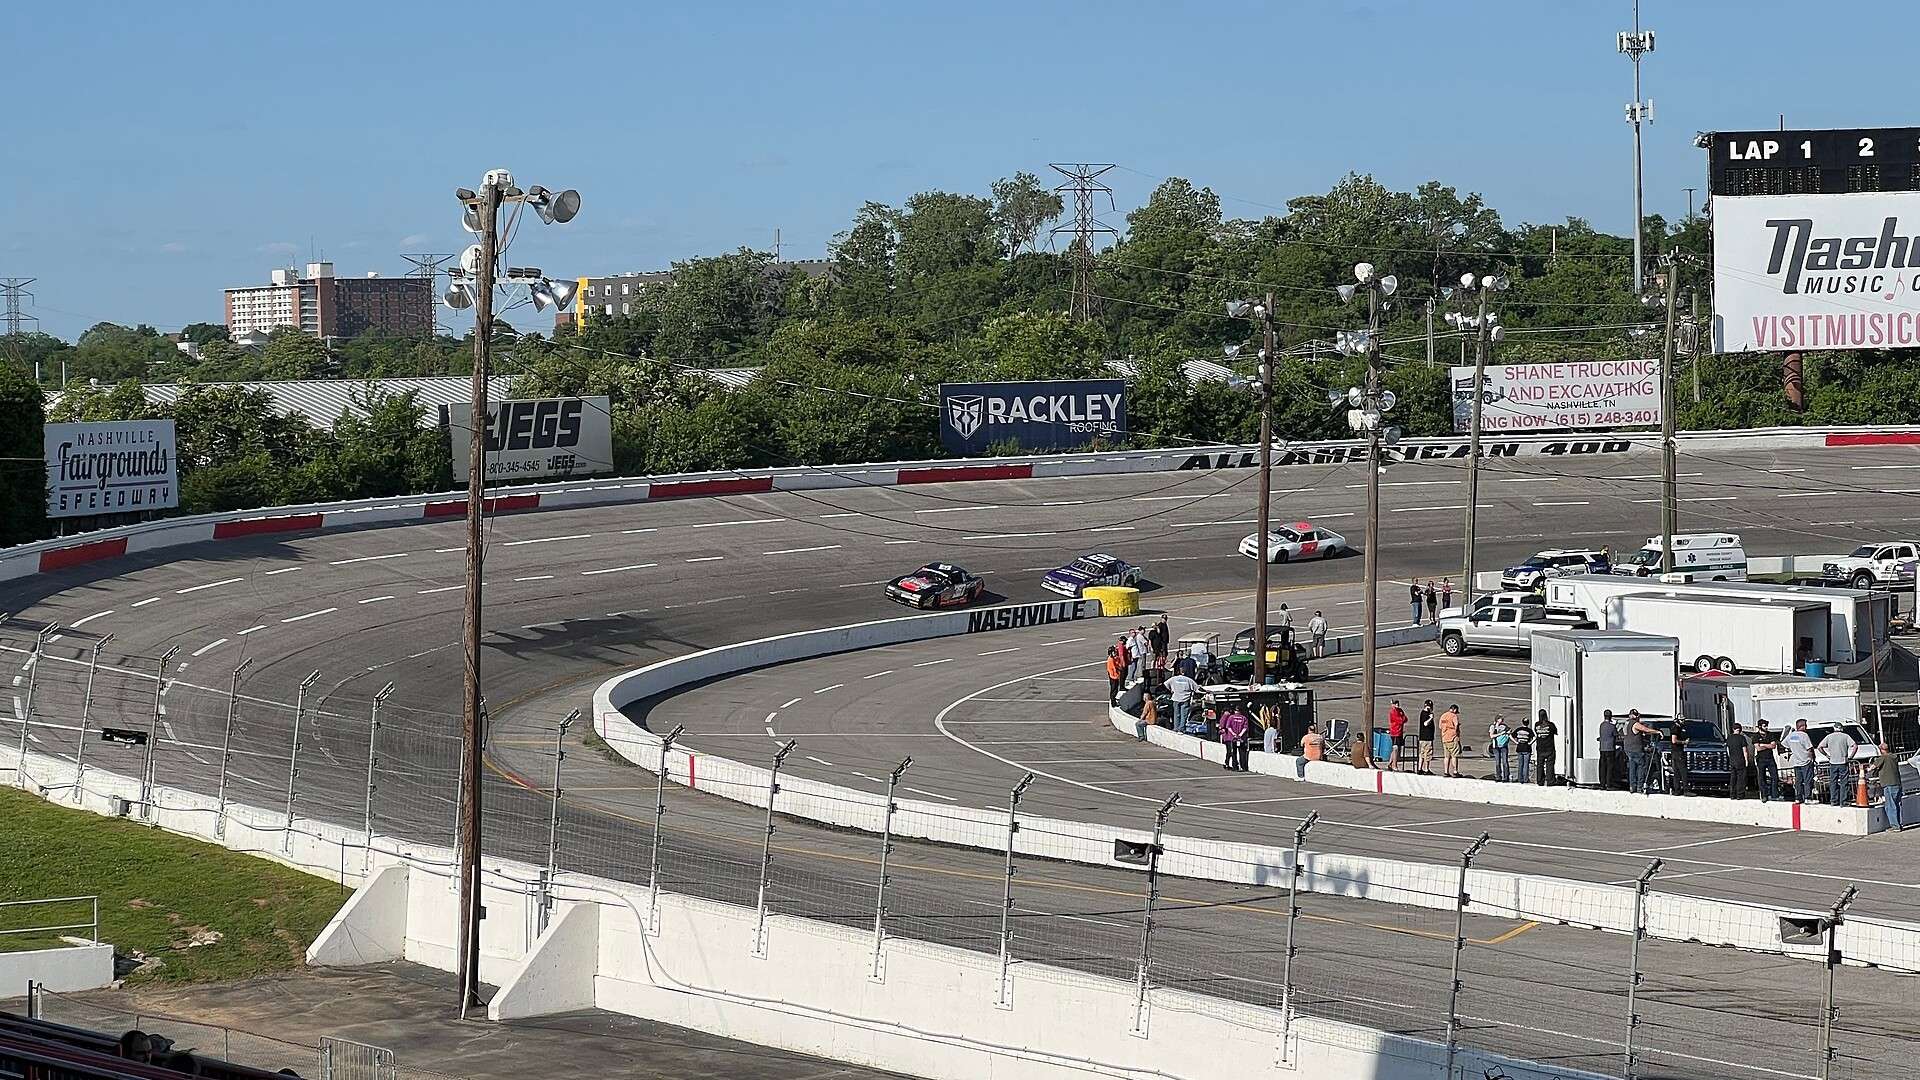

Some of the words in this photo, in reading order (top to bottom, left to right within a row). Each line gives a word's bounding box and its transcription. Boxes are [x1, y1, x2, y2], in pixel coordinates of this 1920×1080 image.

[1729, 140, 1780, 160] LAP
[1800, 140, 1812, 159] 1
[1858, 137, 1875, 157] 2
[1804, 275, 1885, 294] MUSIC
[1505, 365, 1565, 381] SHANE
[1567, 361, 1655, 378] TRUCKING
[1509, 386, 1545, 401] AND
[1550, 382, 1654, 400] EXCAVATING
[988, 393, 1122, 425] RACKLEY
[1603, 400, 1616, 408] TN
[485, 400, 583, 452] JEGS
[1070, 421, 1117, 433] ROOFING
[1512, 415, 1548, 427] NOW
[1555, 413, 1590, 427] (615)
[1595, 410, 1660, 425] 248-3401
[78, 430, 154, 446] NASHVILLE
[58, 441, 168, 490] Fairgrounds
[1177, 452, 1262, 470] ALL
[1540, 440, 1631, 456] 400
[60, 487, 169, 511] SPEEDWAY
[967, 601, 1085, 633] NASHVILLE
